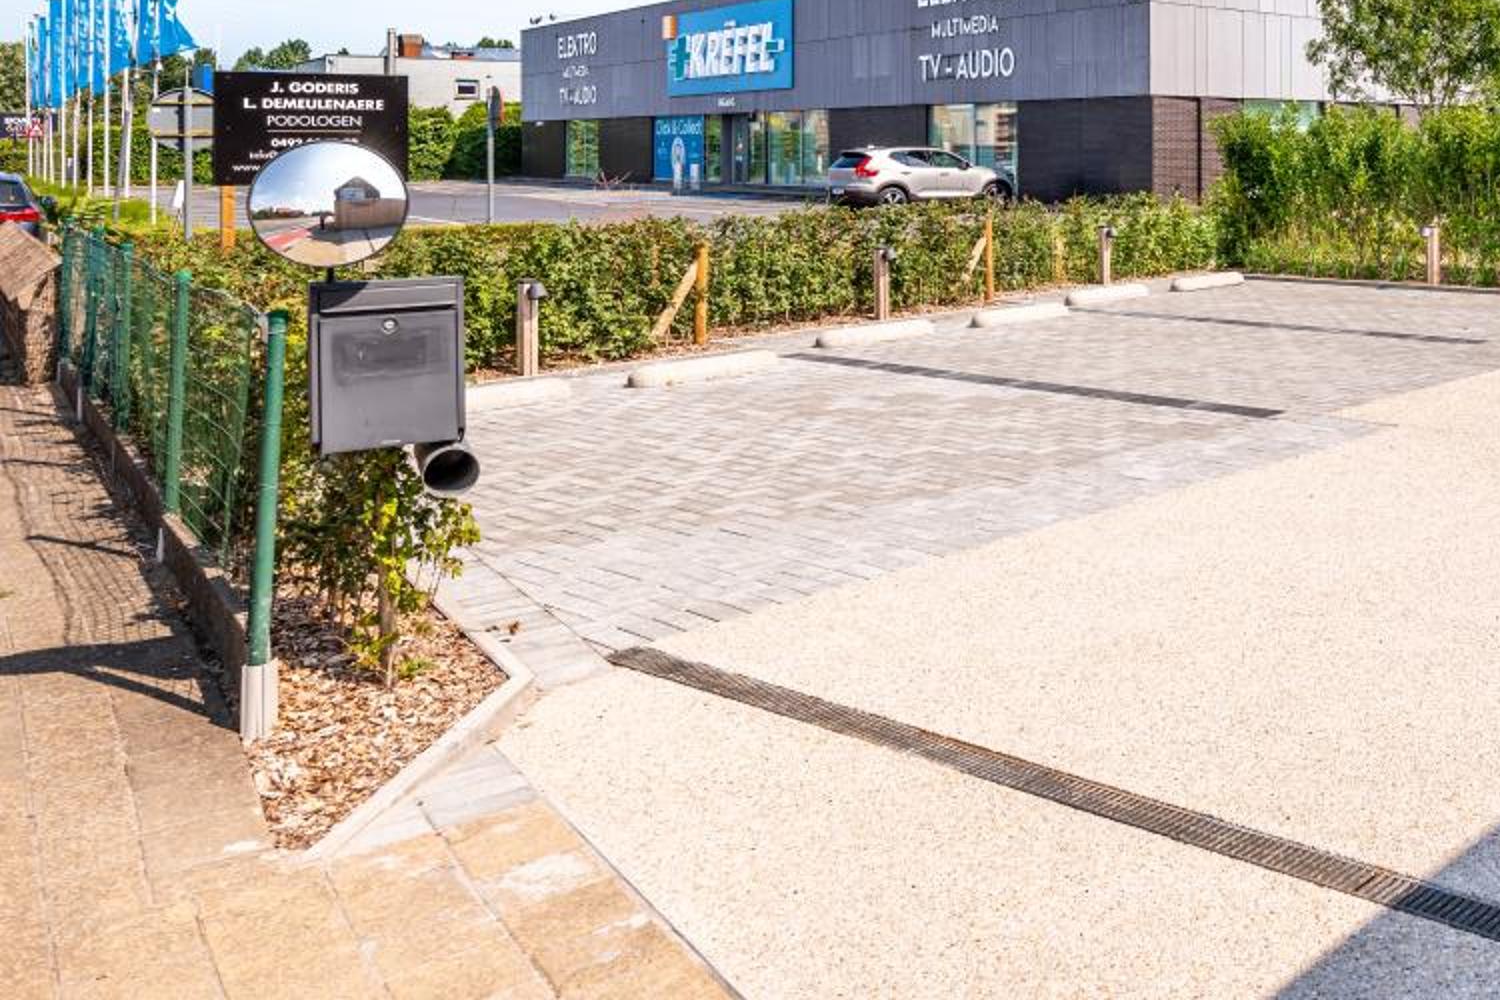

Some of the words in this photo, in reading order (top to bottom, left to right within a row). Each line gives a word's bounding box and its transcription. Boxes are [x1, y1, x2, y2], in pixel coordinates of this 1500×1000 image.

[269, 82, 284, 94] J.
[289, 81, 359, 95] GODERIS
[262, 97, 385, 111] DEMEULENAERE
[267, 115, 363, 127] PODOLOGEN
